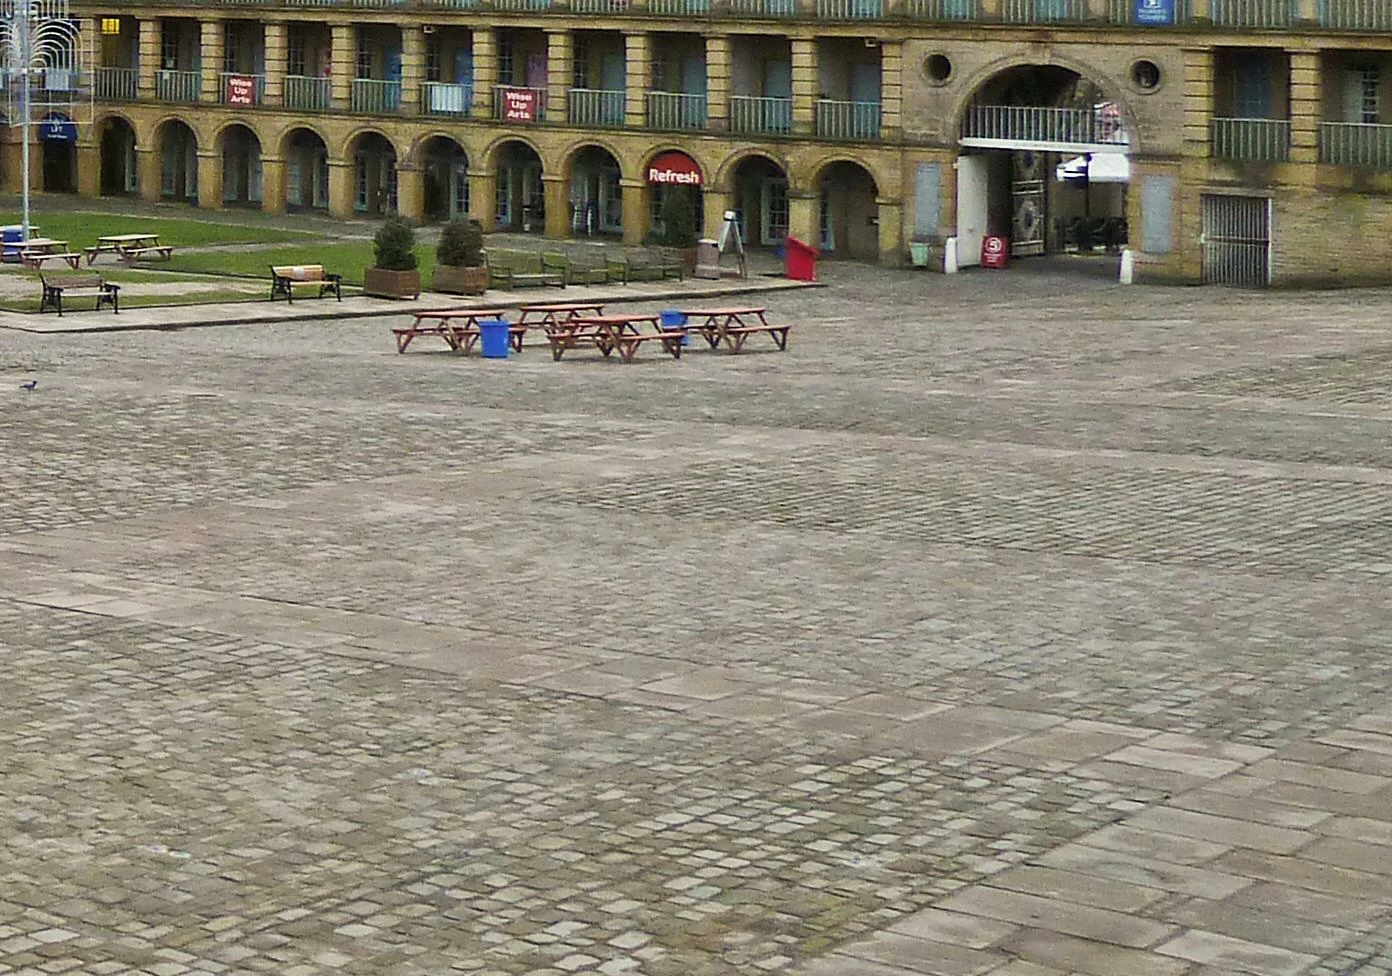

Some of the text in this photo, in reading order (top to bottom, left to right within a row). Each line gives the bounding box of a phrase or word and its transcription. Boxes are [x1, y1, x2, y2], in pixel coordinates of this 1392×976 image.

[506, 92, 533, 101] Wise
[511, 101, 527, 110] Up
[507, 110, 531, 119] Arts
[649, 168, 700, 184] Refresh
